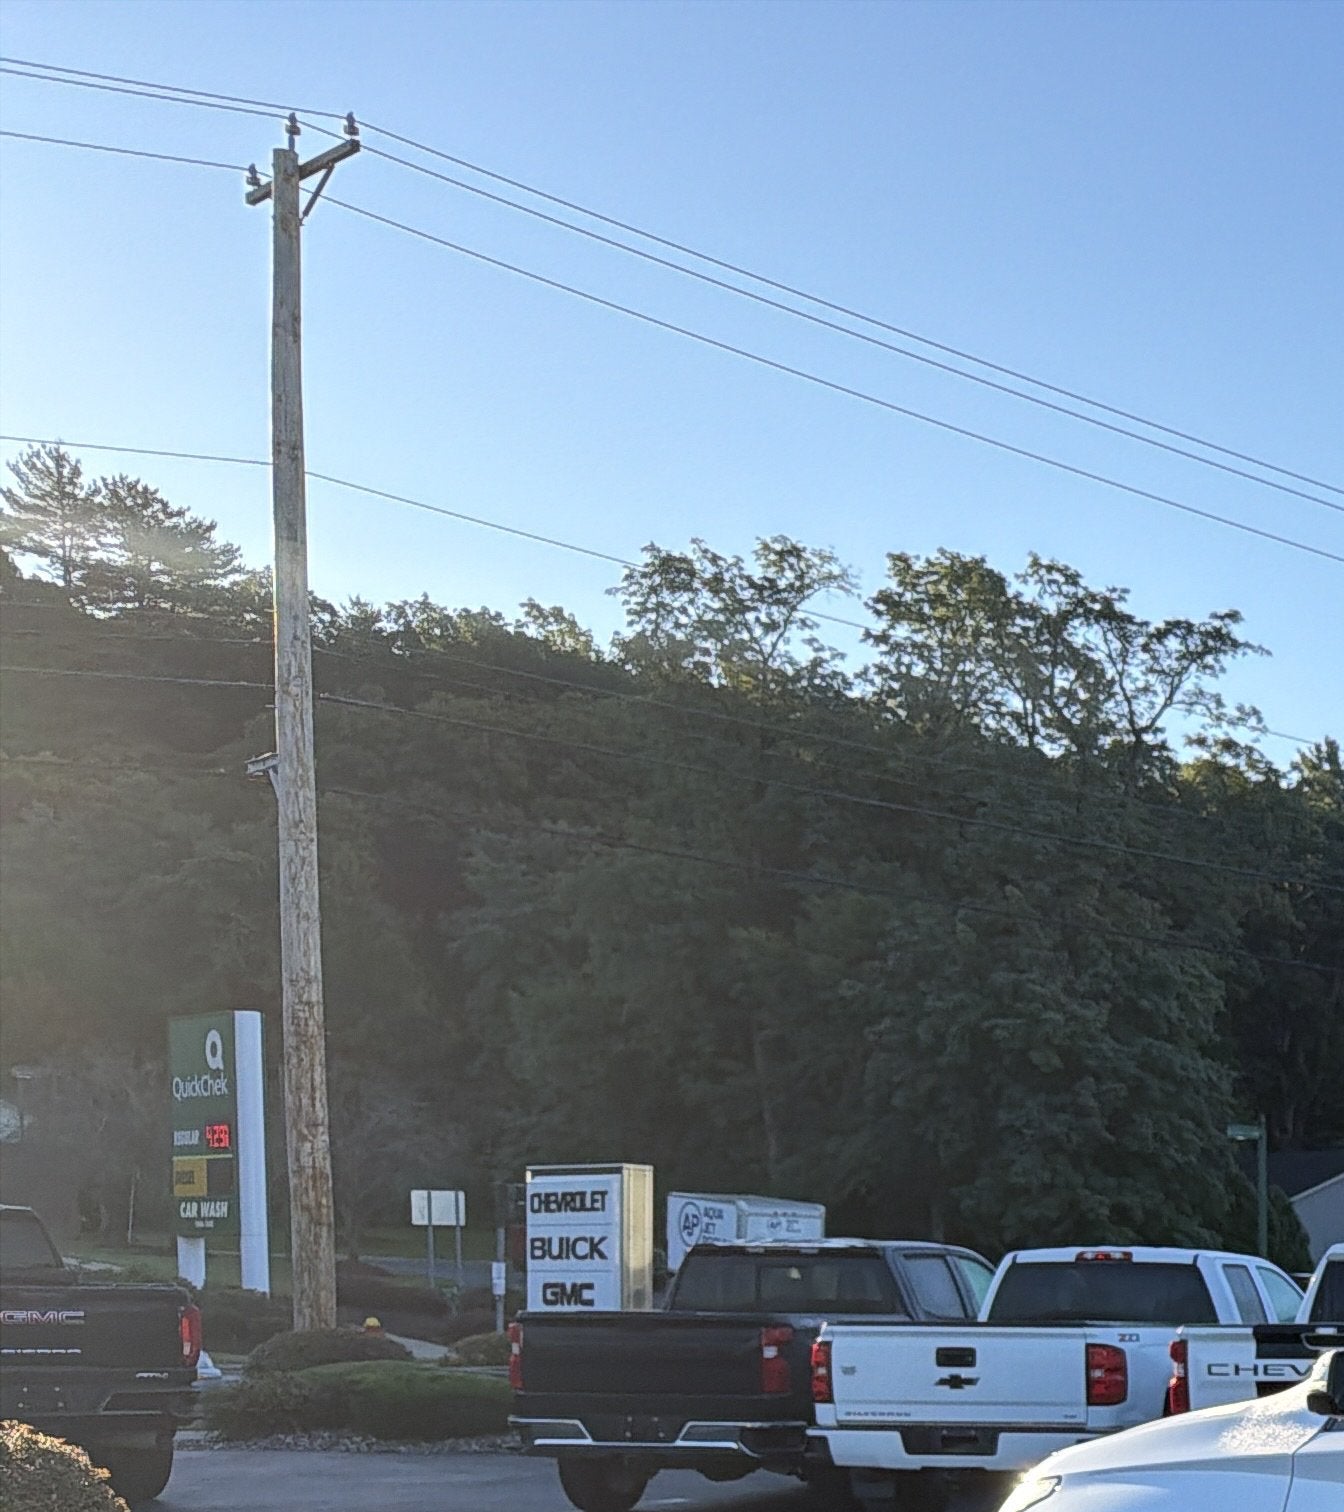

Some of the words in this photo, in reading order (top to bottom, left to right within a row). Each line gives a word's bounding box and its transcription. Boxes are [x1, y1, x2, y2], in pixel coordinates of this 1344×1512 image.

[172, 1073, 228, 1101] QuickChek
[180, 1201, 198, 1218] CAR
[200, 1201, 228, 1218] WASH
[530, 1190, 608, 1213] CHEVROLET
[530, 1236, 608, 1260] BUICK
[542, 1282, 594, 1307] GMC
[0, 1310, 85, 1325] GMC
